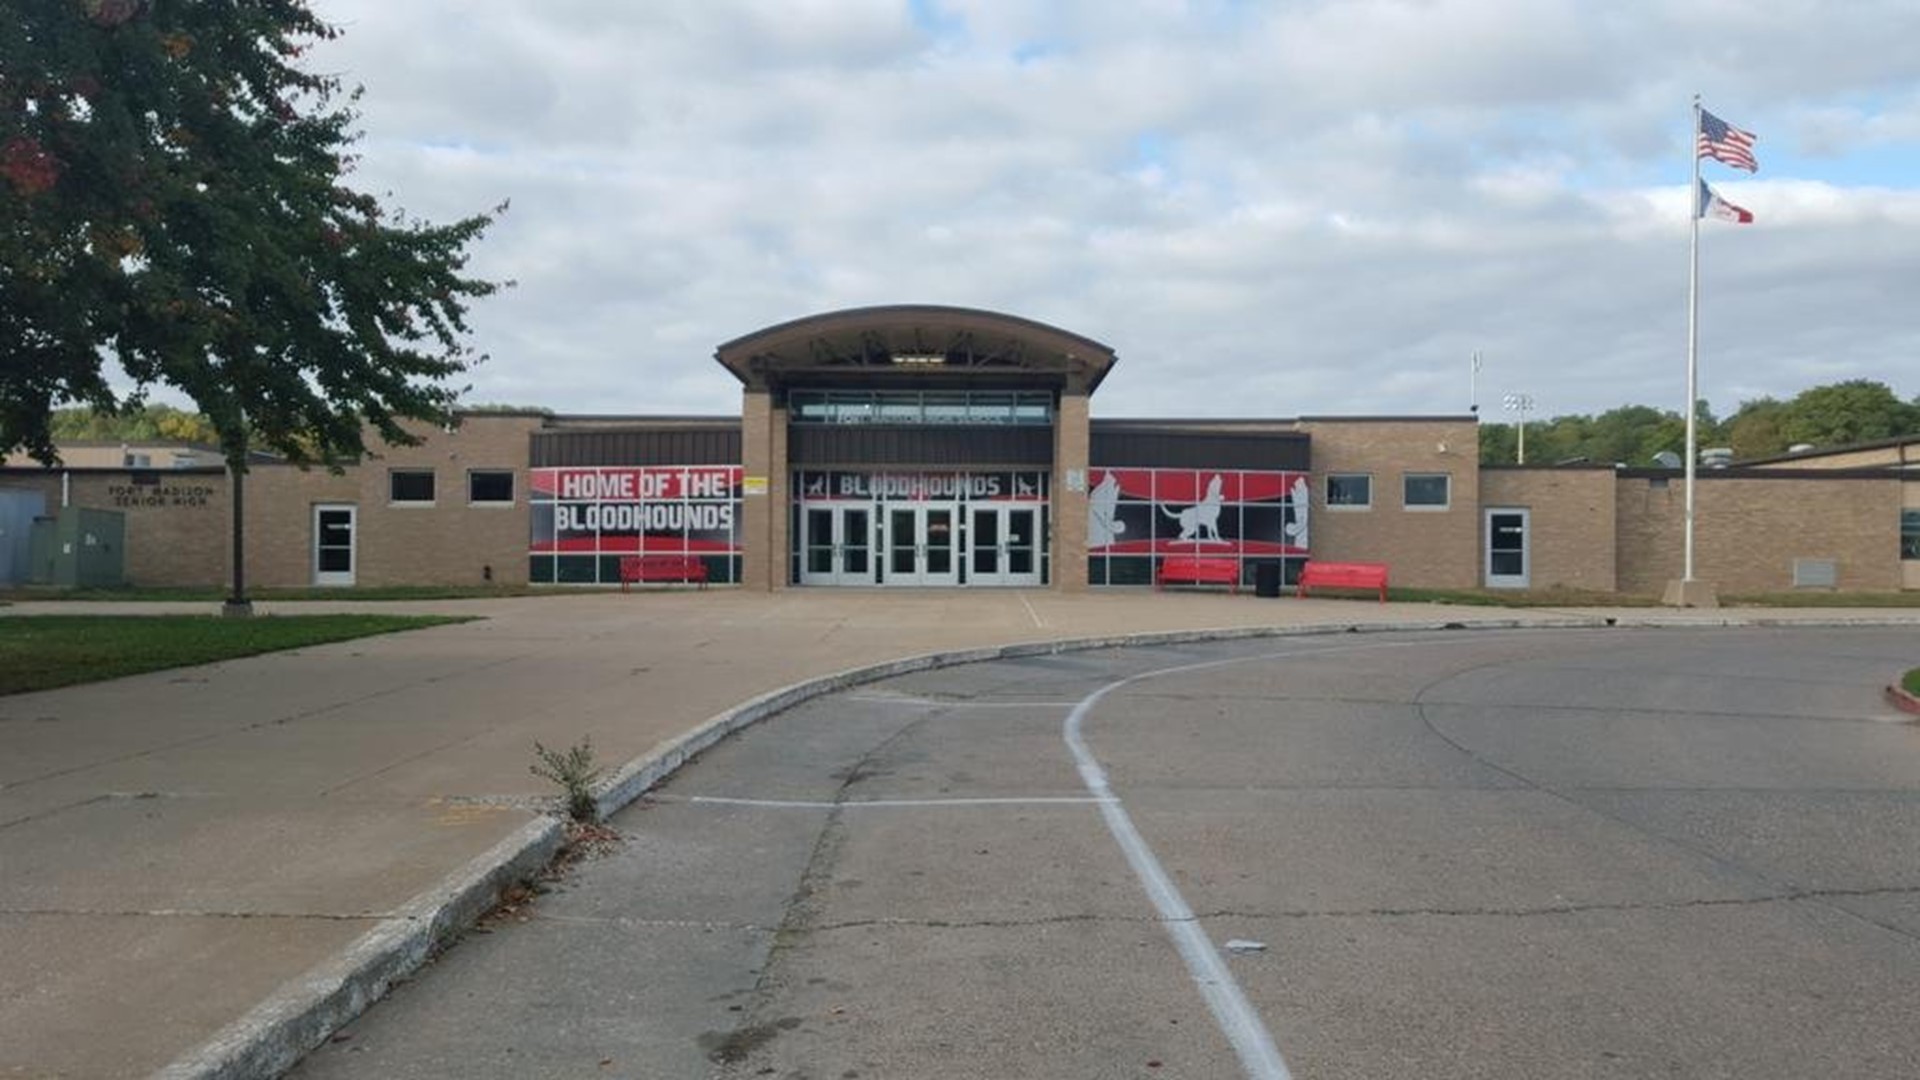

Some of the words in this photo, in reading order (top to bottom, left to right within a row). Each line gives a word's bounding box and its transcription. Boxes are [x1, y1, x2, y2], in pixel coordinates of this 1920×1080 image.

[563, 473, 634, 499] HOME
[638, 473, 670, 498] OF
[676, 472, 727, 498] THE
[839, 475, 1001, 496] BLOODHOUNDS
[555, 504, 734, 531] BLOODHOUNDS
